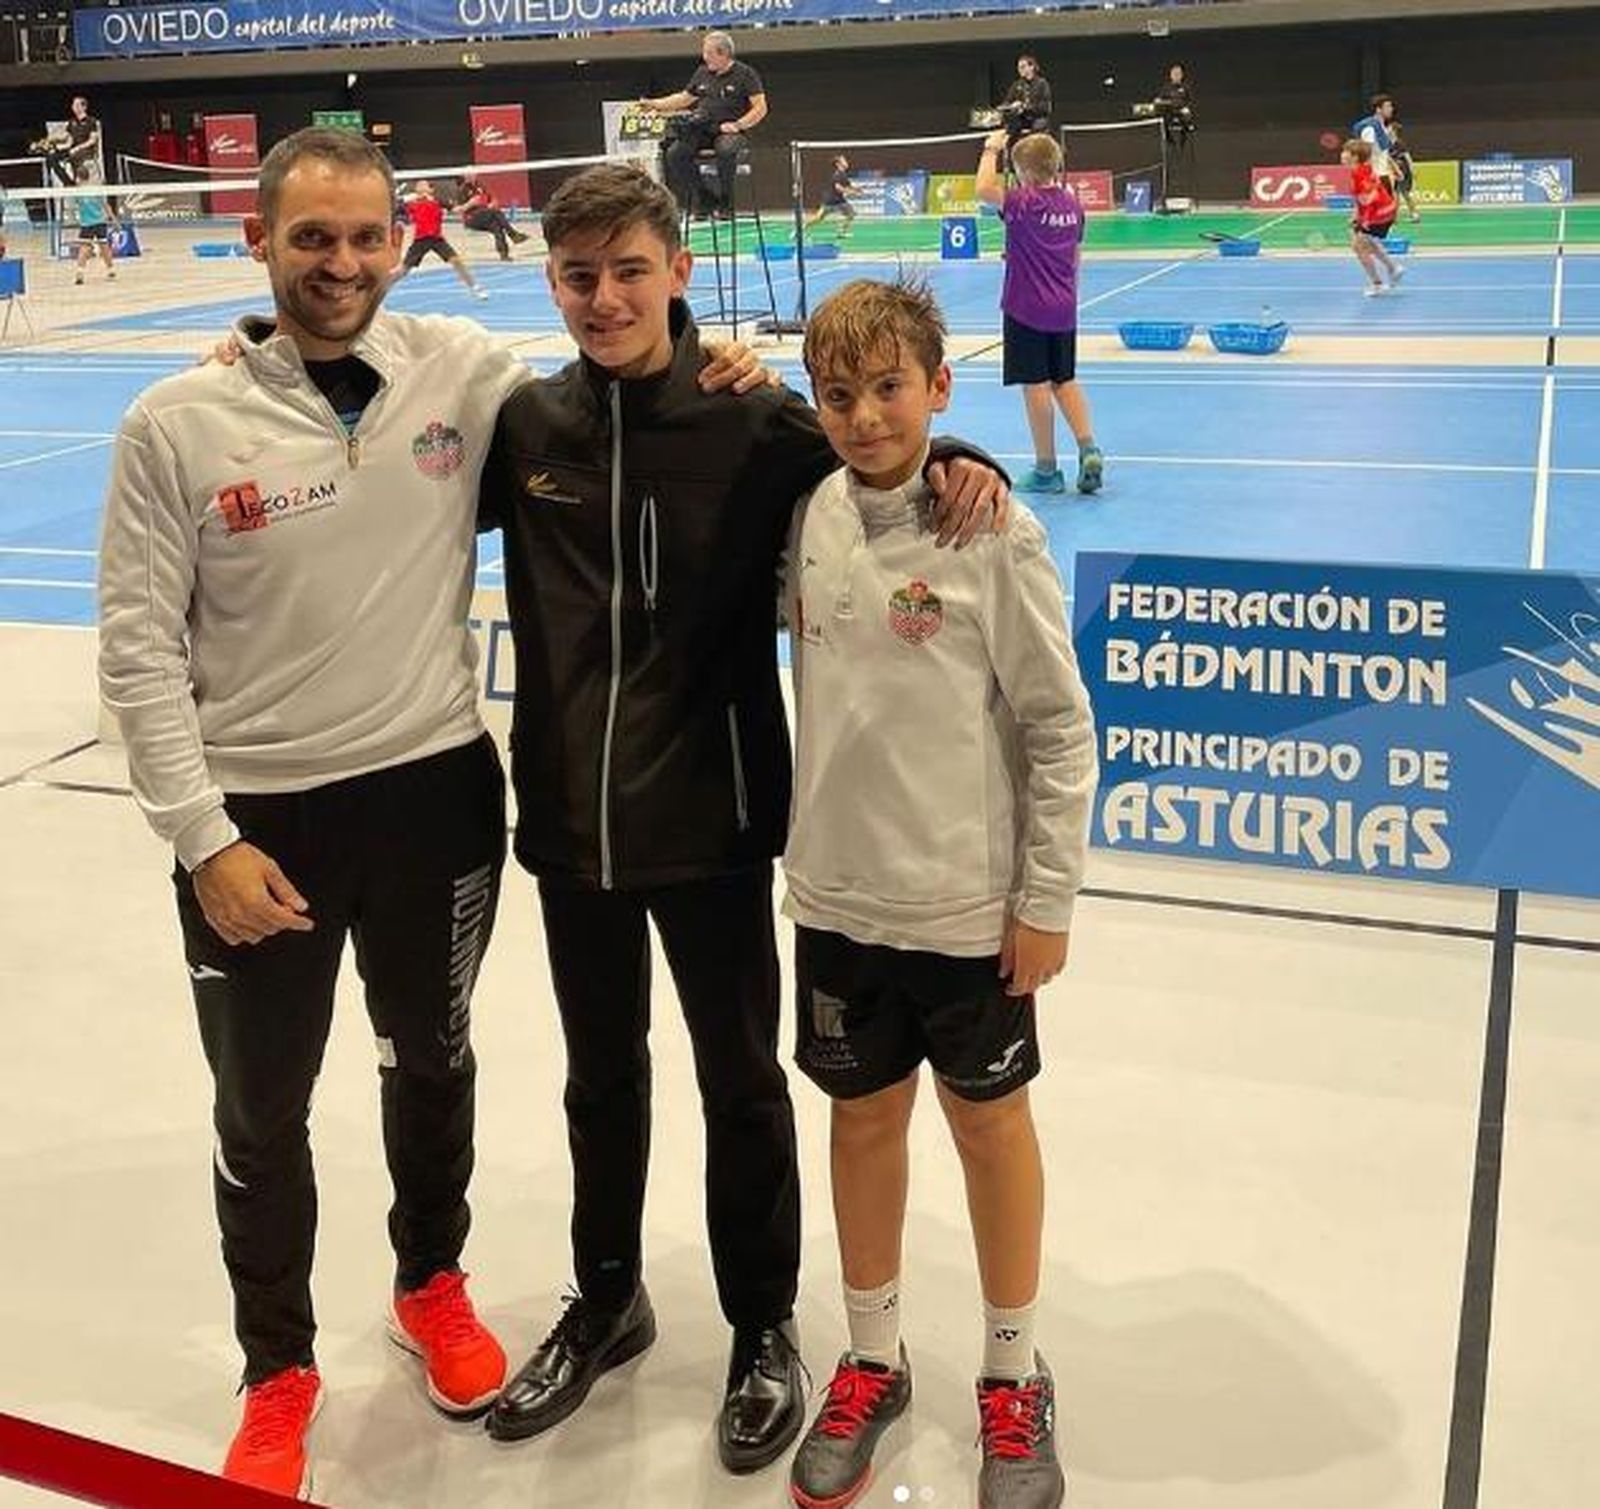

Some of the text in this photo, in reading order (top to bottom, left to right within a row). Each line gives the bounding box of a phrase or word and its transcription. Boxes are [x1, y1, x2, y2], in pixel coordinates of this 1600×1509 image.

[103, 7, 396, 45] OVIEDO capital del deporte
[459, 0, 602, 26] OVIEDO
[609, 0, 677, 21] capital
[950, 225, 967, 248] 6
[1108, 582, 1448, 637] FEDERACIÓN DE
[1106, 630, 1448, 705] BÁDMINTON
[1106, 726, 1450, 792] PRINCIPADO DE
[1102, 781, 1452, 871] ASTURIAS
